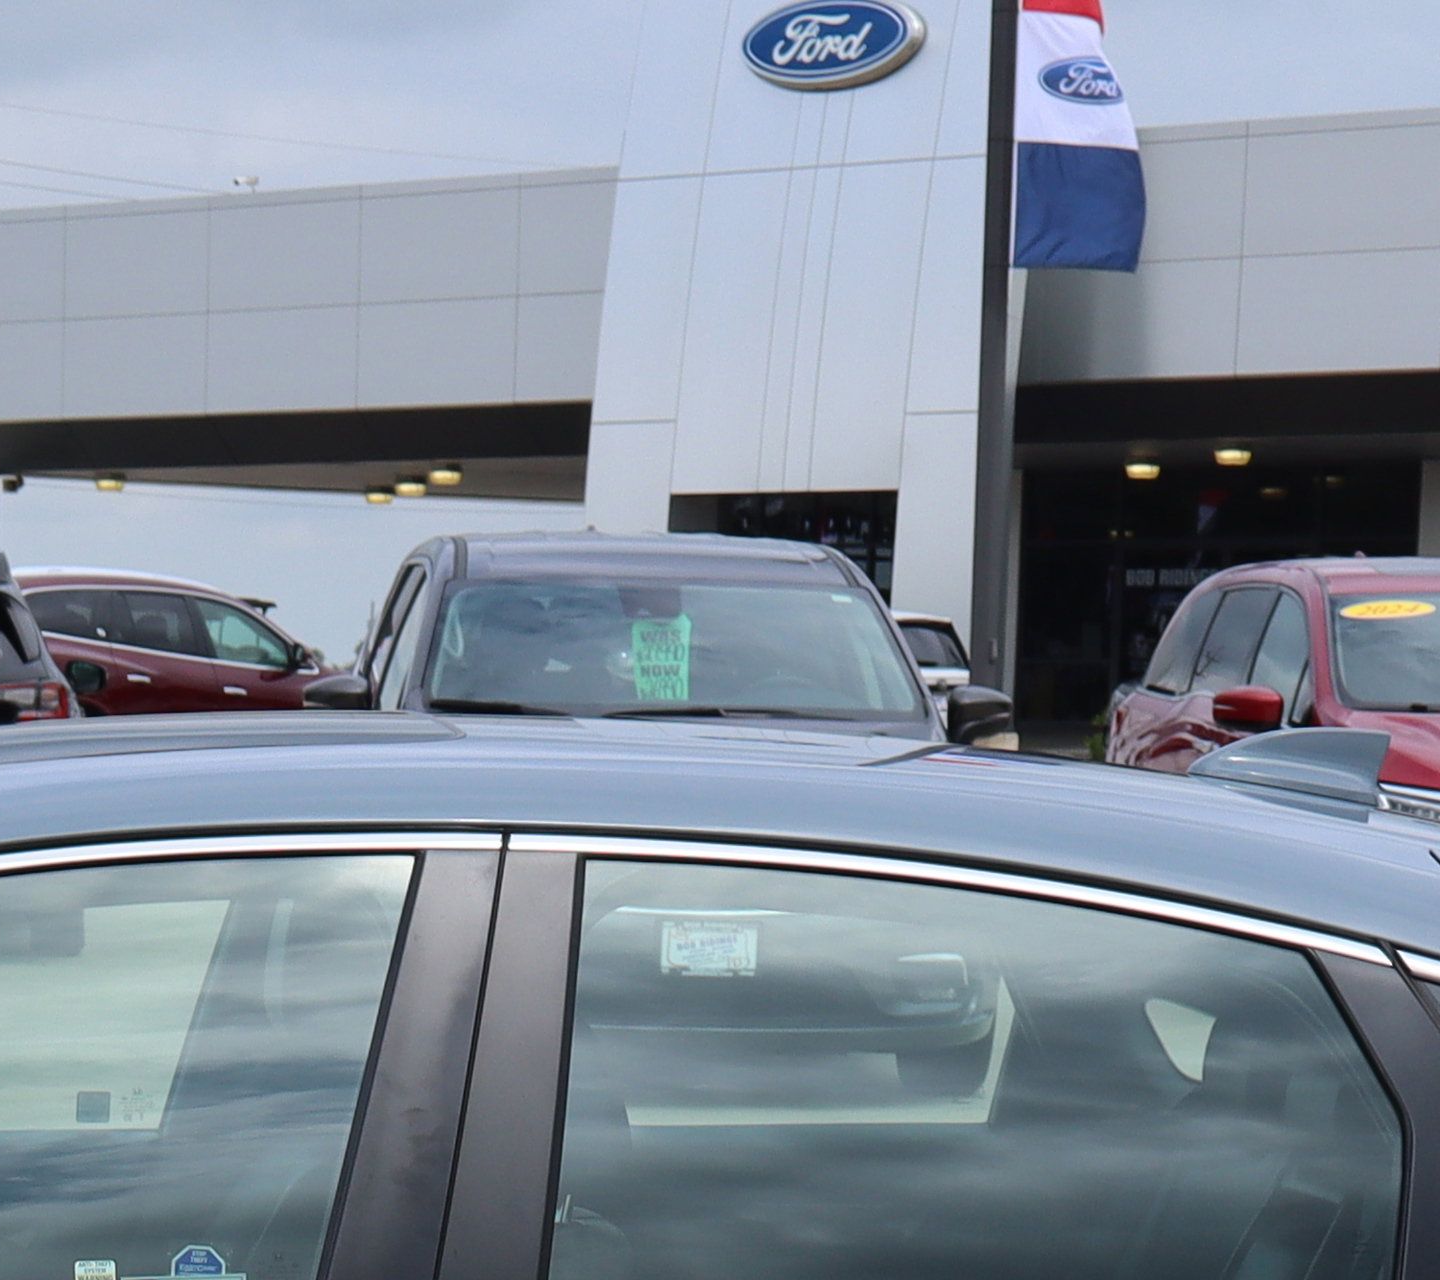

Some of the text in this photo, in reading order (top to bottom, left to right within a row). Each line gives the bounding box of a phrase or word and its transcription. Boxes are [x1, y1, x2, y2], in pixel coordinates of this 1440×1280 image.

[771, 12, 874, 66] Ford
[1058, 64, 1120, 97] Ford
[1158, 568, 1221, 587] RIDING
[640, 663, 680, 678] NOW
